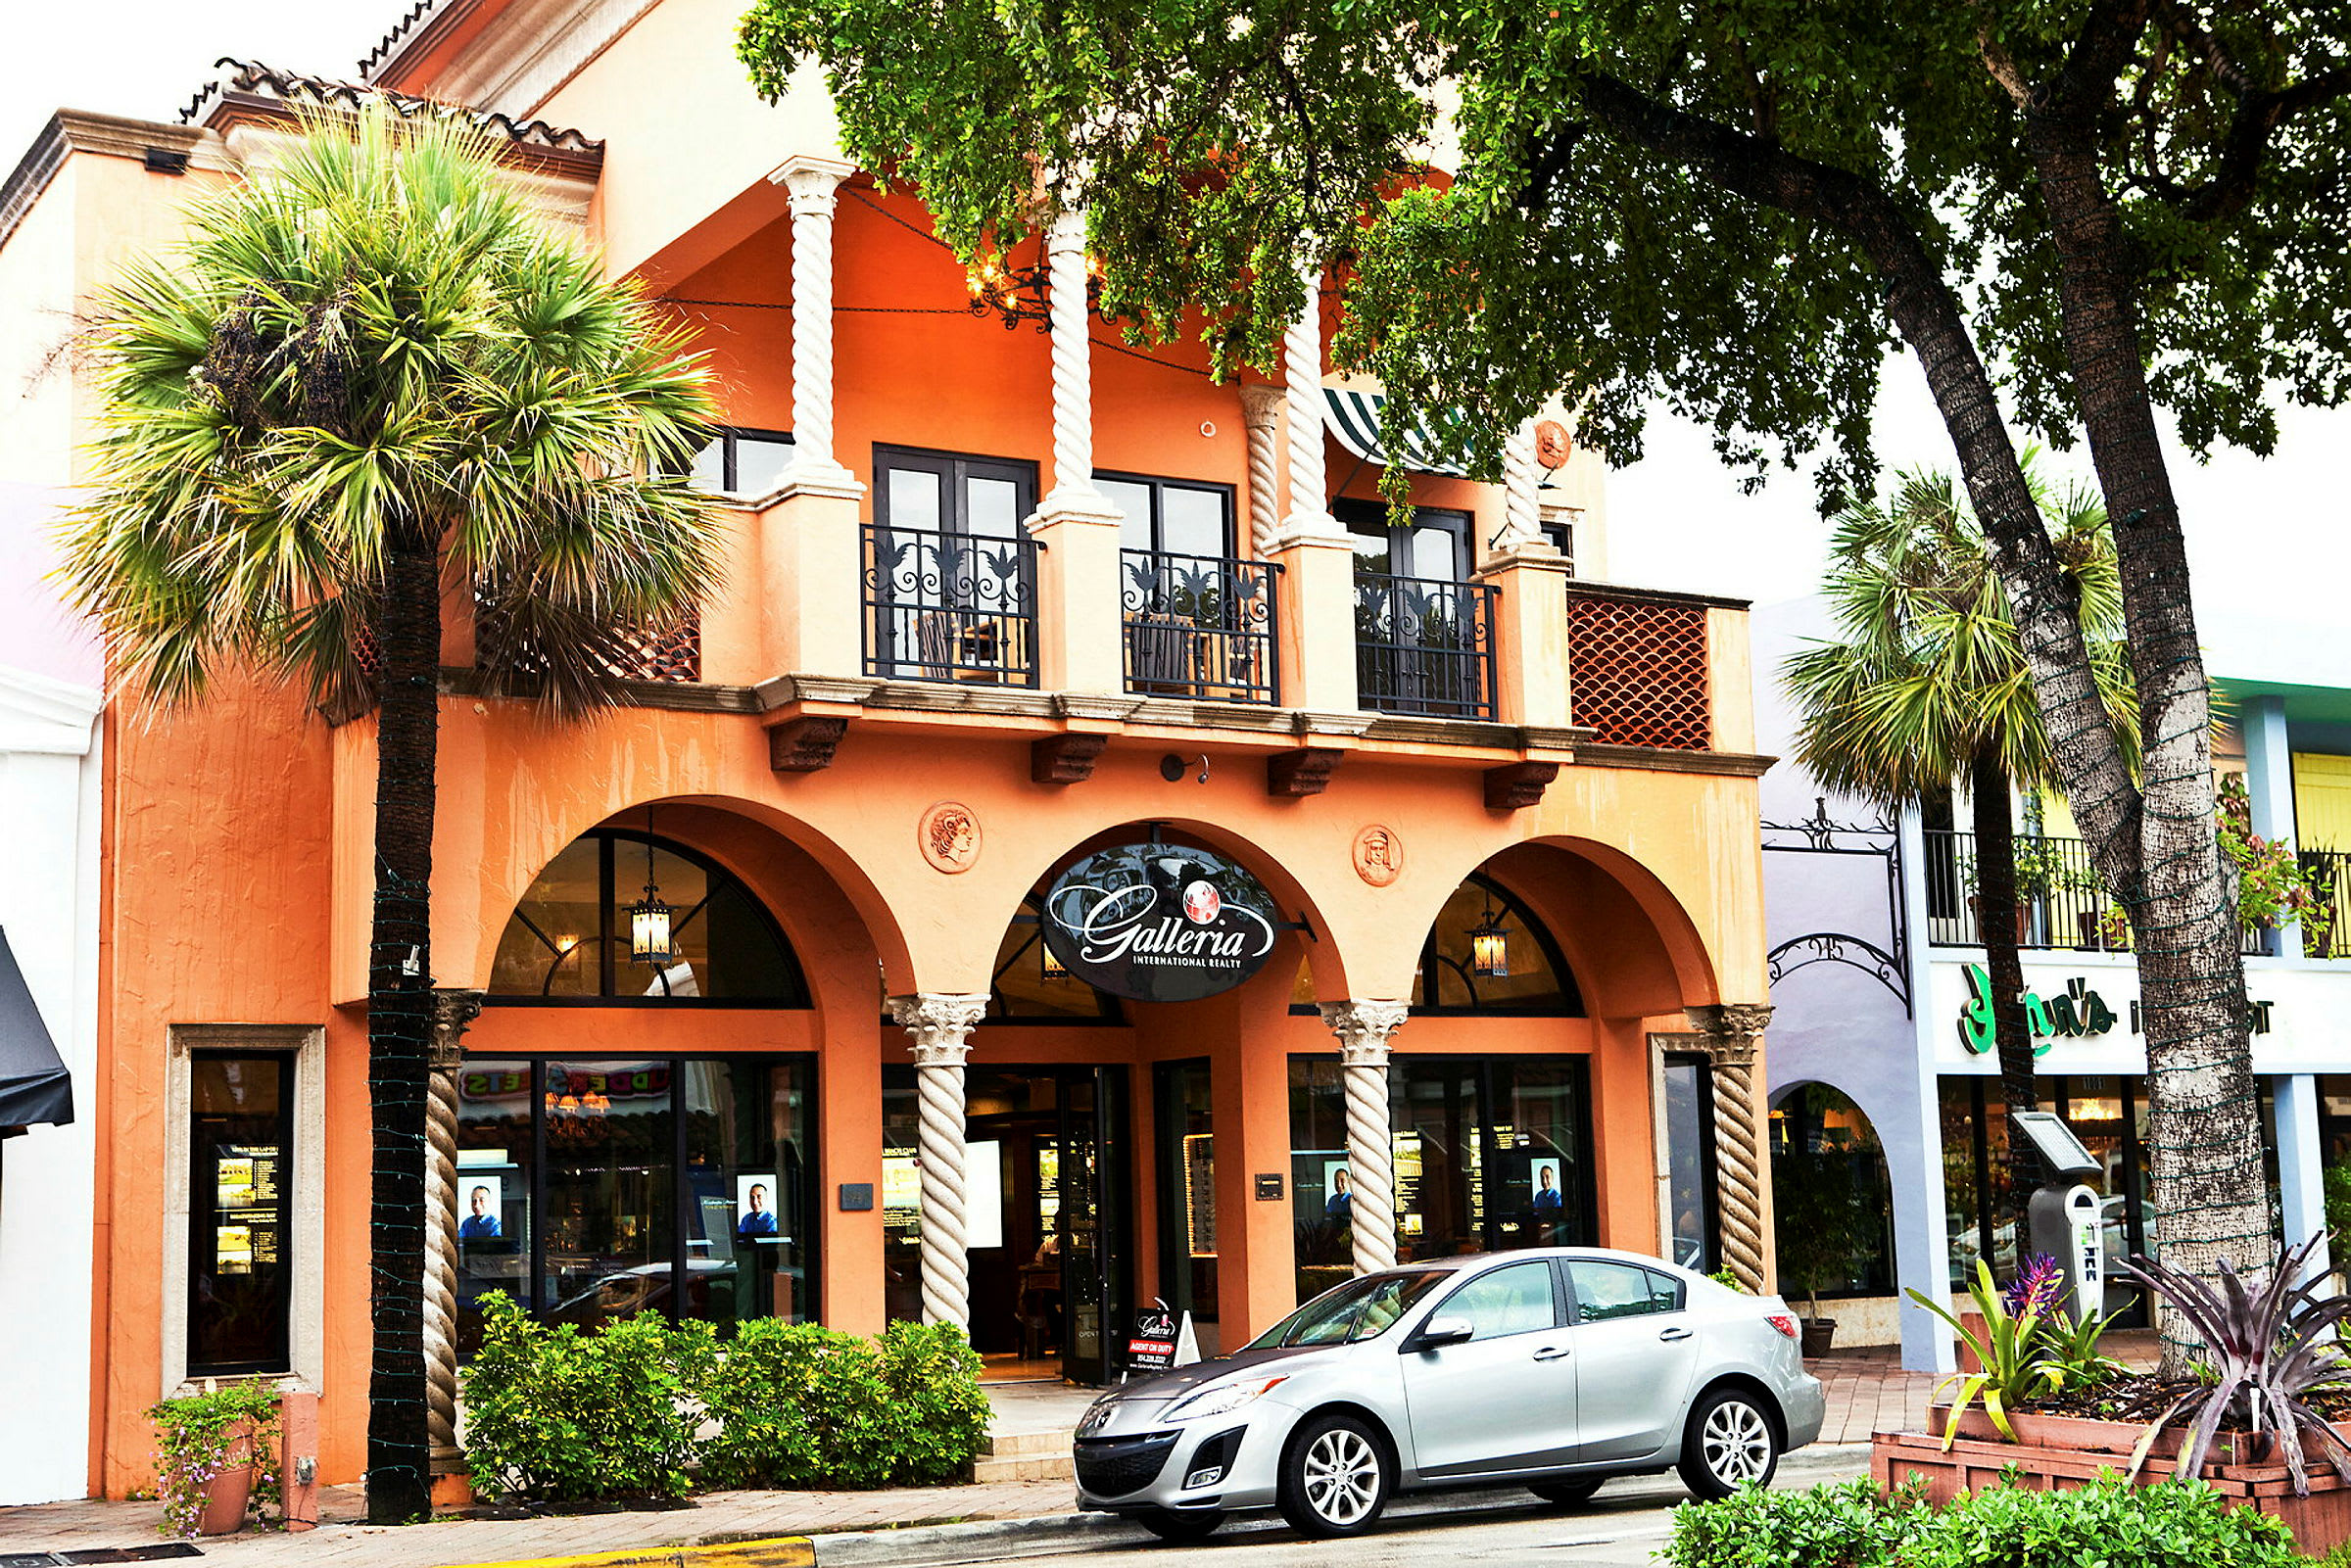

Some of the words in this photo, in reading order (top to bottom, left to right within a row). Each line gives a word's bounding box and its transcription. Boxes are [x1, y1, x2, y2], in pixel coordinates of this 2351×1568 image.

[1049, 884, 1246, 964] Galleria
[1132, 955, 1206, 968] INTERNATIONAL
[1209, 959, 1242, 969] REALTY
[1129, 1342, 1149, 1351] AGENT
[1157, 1345, 1174, 1354] DUTY
